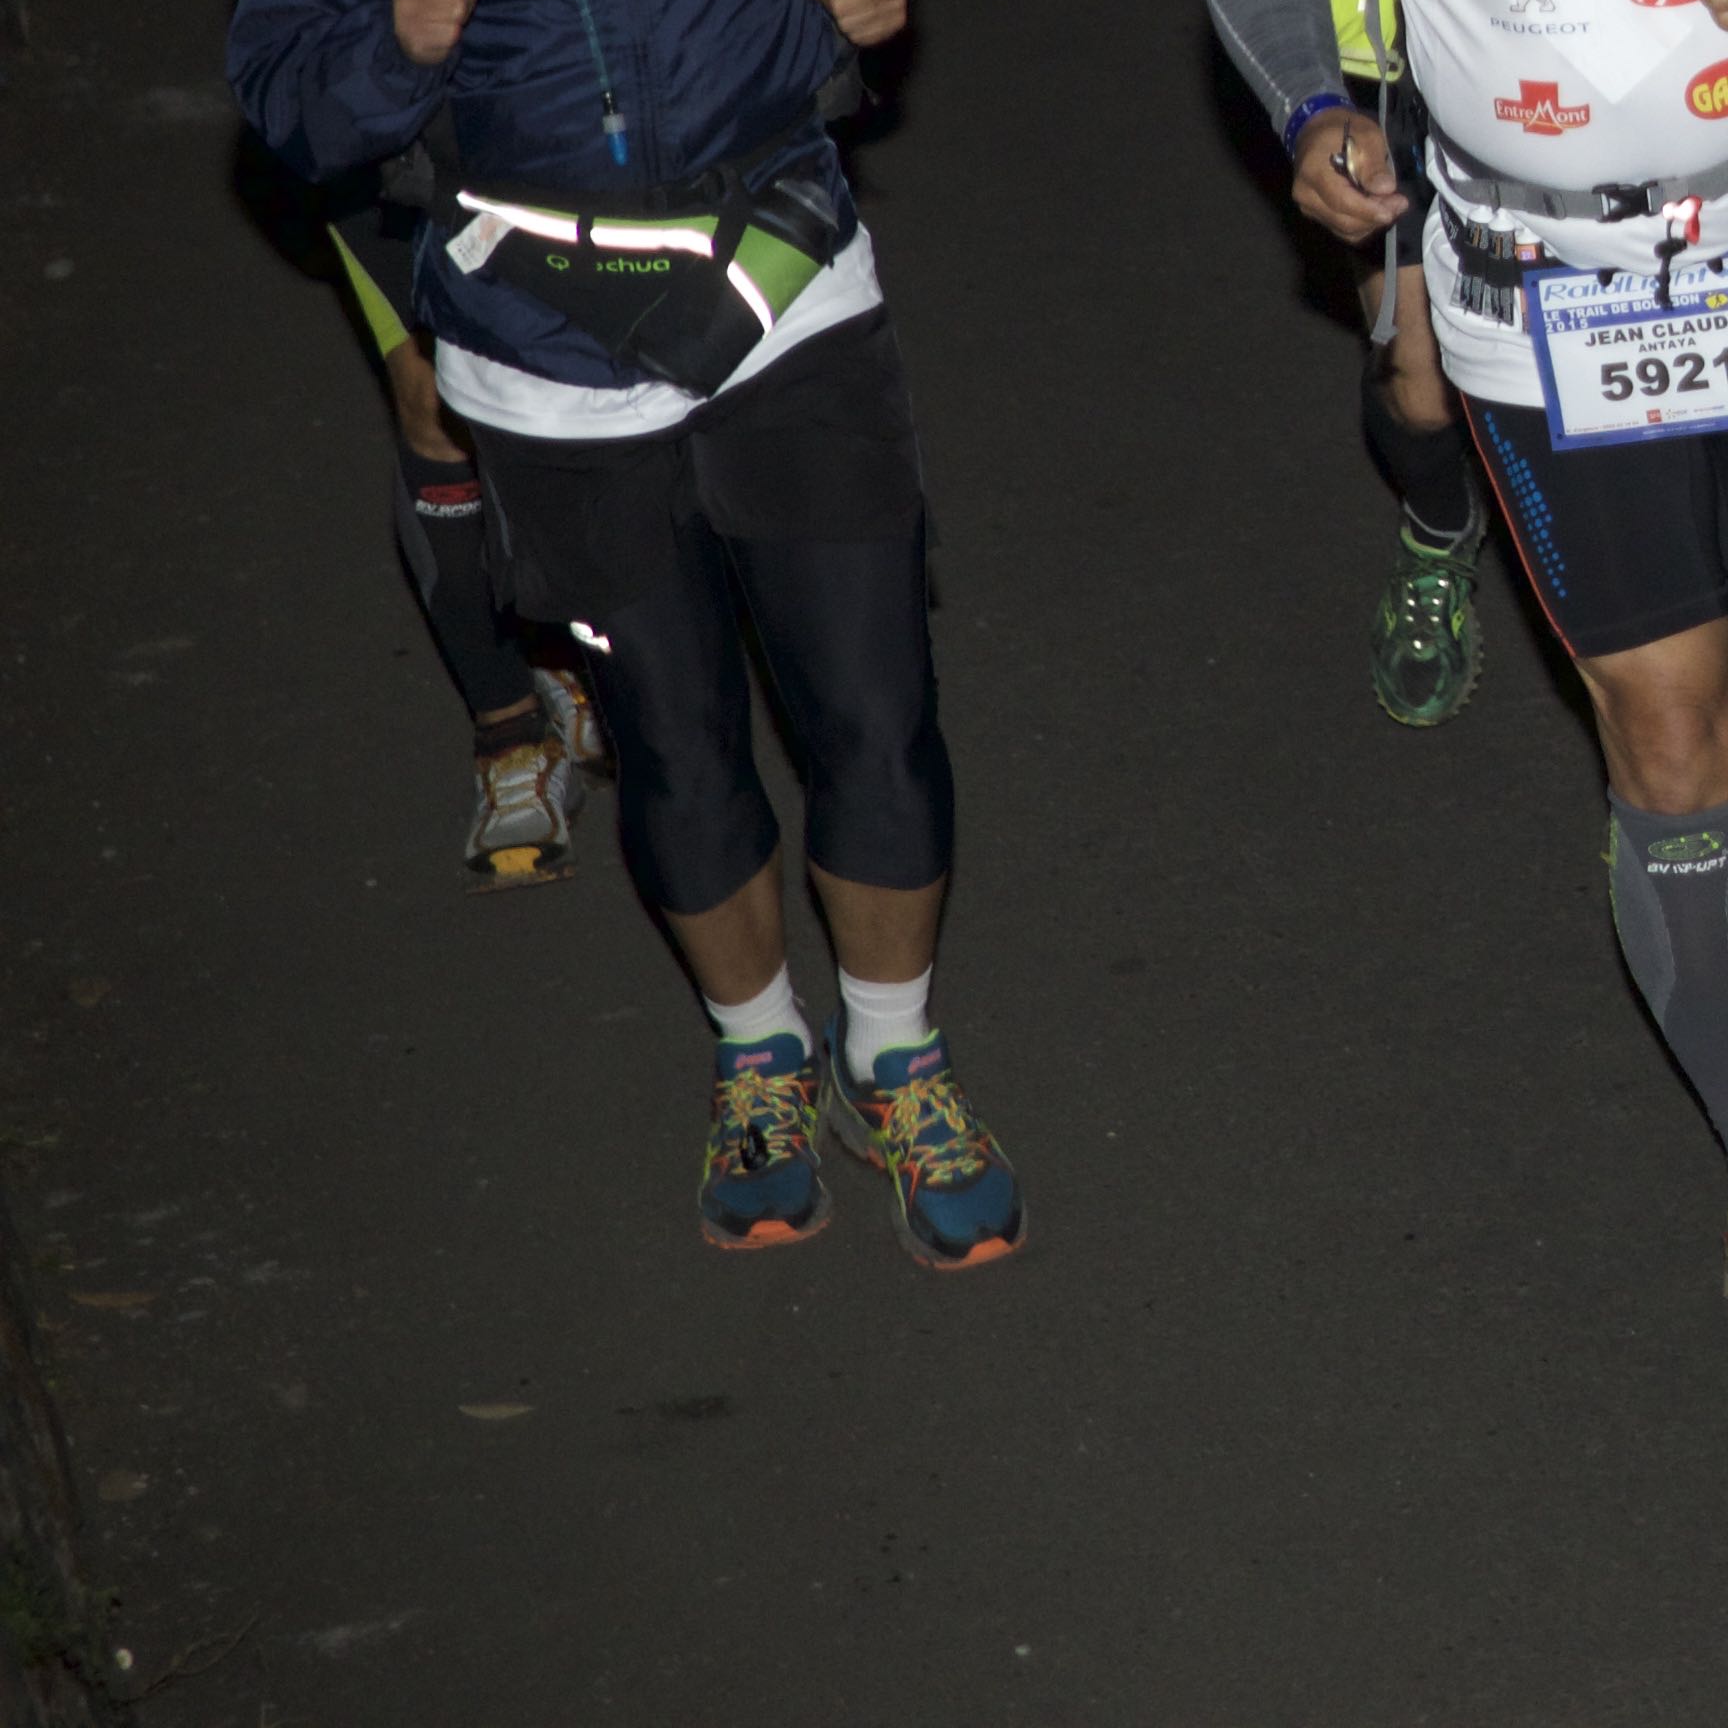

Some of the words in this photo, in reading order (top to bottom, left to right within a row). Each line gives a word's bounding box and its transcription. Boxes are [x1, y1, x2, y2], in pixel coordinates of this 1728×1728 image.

[1490, 17, 1591, 35] PEUGEOT
[546, 253, 671, 272] Qchua
[1542, 308, 1561, 322] LE
[1566, 302, 1609, 320] TRAIL
[1611, 300, 1629, 315] DE
[1632, 292, 1700, 313] BOUBON
[1545, 318, 1589, 334] 2015
[1584, 323, 1644, 348] JEAN
[1638, 336, 1697, 354] ANTAYA
